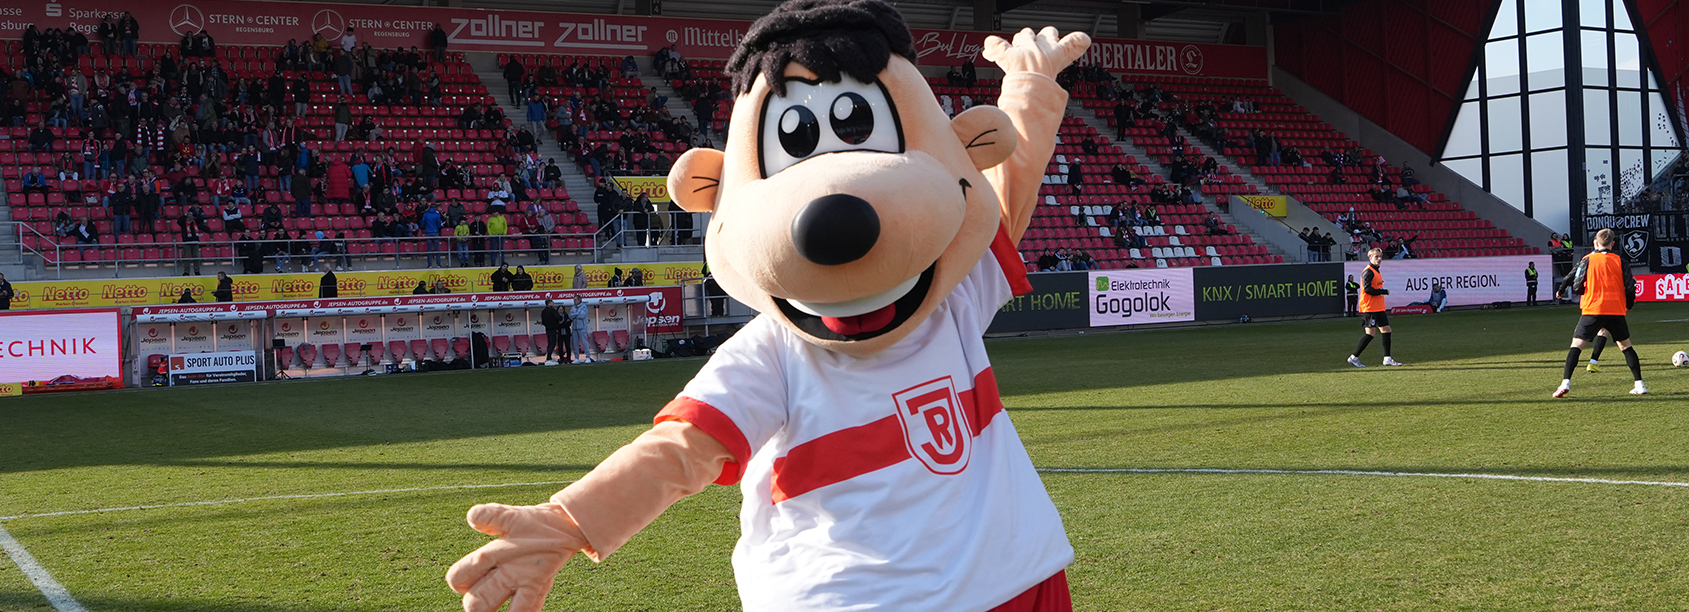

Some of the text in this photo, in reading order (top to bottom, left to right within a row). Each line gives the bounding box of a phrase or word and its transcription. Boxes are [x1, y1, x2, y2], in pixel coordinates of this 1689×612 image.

[69, 7, 125, 20] Sparkasse
[209, 14, 299, 26] STERN CENTER
[70, 21, 99, 35] Rege
[349, 18, 433, 30] STERN CENTER
[1072, 42, 1178, 71] ABERTALER
[618, 181, 667, 198] Netto
[1586, 214, 1651, 230] DONAU CREW
[428, 274, 467, 287] Netto
[584, 269, 611, 282] etto
[664, 267, 699, 280] Netto
[231, 281, 260, 294] etto
[271, 279, 314, 293] Netto
[337, 278, 366, 292] etto
[377, 276, 417, 290] Netto
[1111, 278, 1170, 291] Elektrotechnik
[1406, 274, 1500, 291] AUS DER REGION.
[42, 286, 89, 301] Netto
[101, 284, 147, 299] Netto
[1203, 280, 1338, 302] KNX / SMART HOME
[244, 303, 307, 311] JEPSEN-AUTOGRUPPE.de
[1030, 291, 1081, 311] HOME
[1096, 291, 1170, 317] Gogolok
[158, 306, 223, 314] JEPSEN-AUTOGRUPPE.de
[633, 315, 680, 328] Jepsen
[187, 355, 255, 368] SPORT AUTO PLUS
